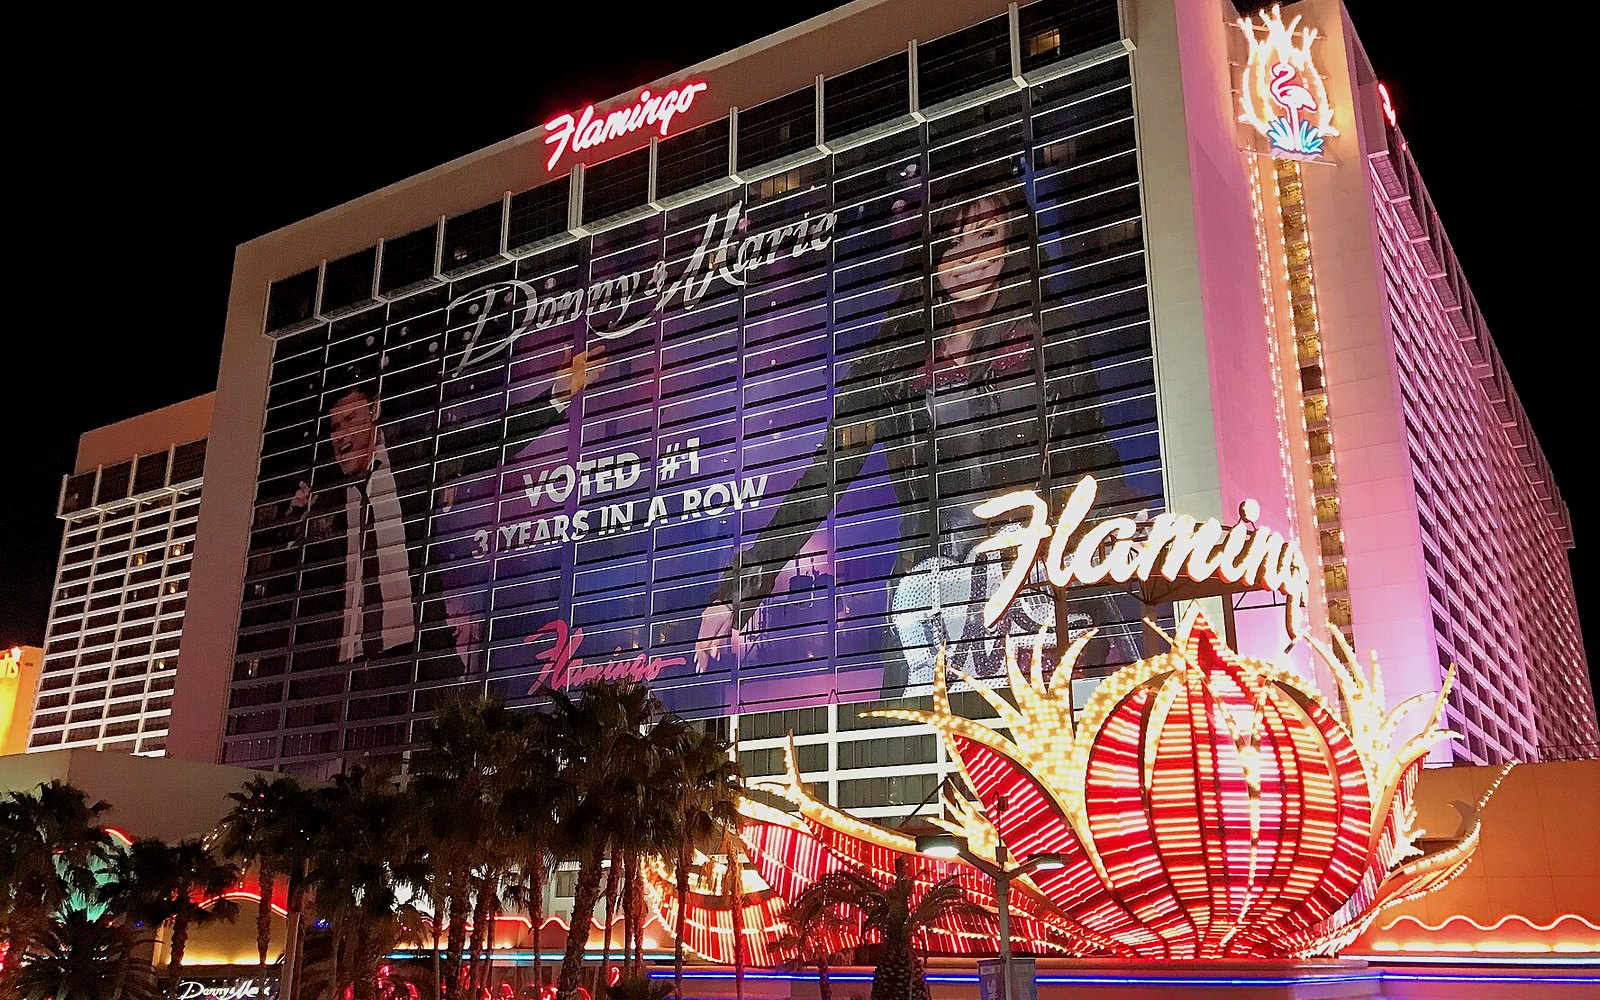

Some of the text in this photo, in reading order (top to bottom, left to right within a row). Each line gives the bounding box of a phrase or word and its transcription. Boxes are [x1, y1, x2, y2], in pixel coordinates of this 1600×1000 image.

[544, 82, 707, 171] Flamingo
[443, 279, 660, 377] Donny
[655, 199, 838, 312] Marie
[523, 437, 701, 507] VOTED #1
[472, 476, 768, 559] 3 YEARS IN A ROW
[523, 619, 686, 696] Flamingo
